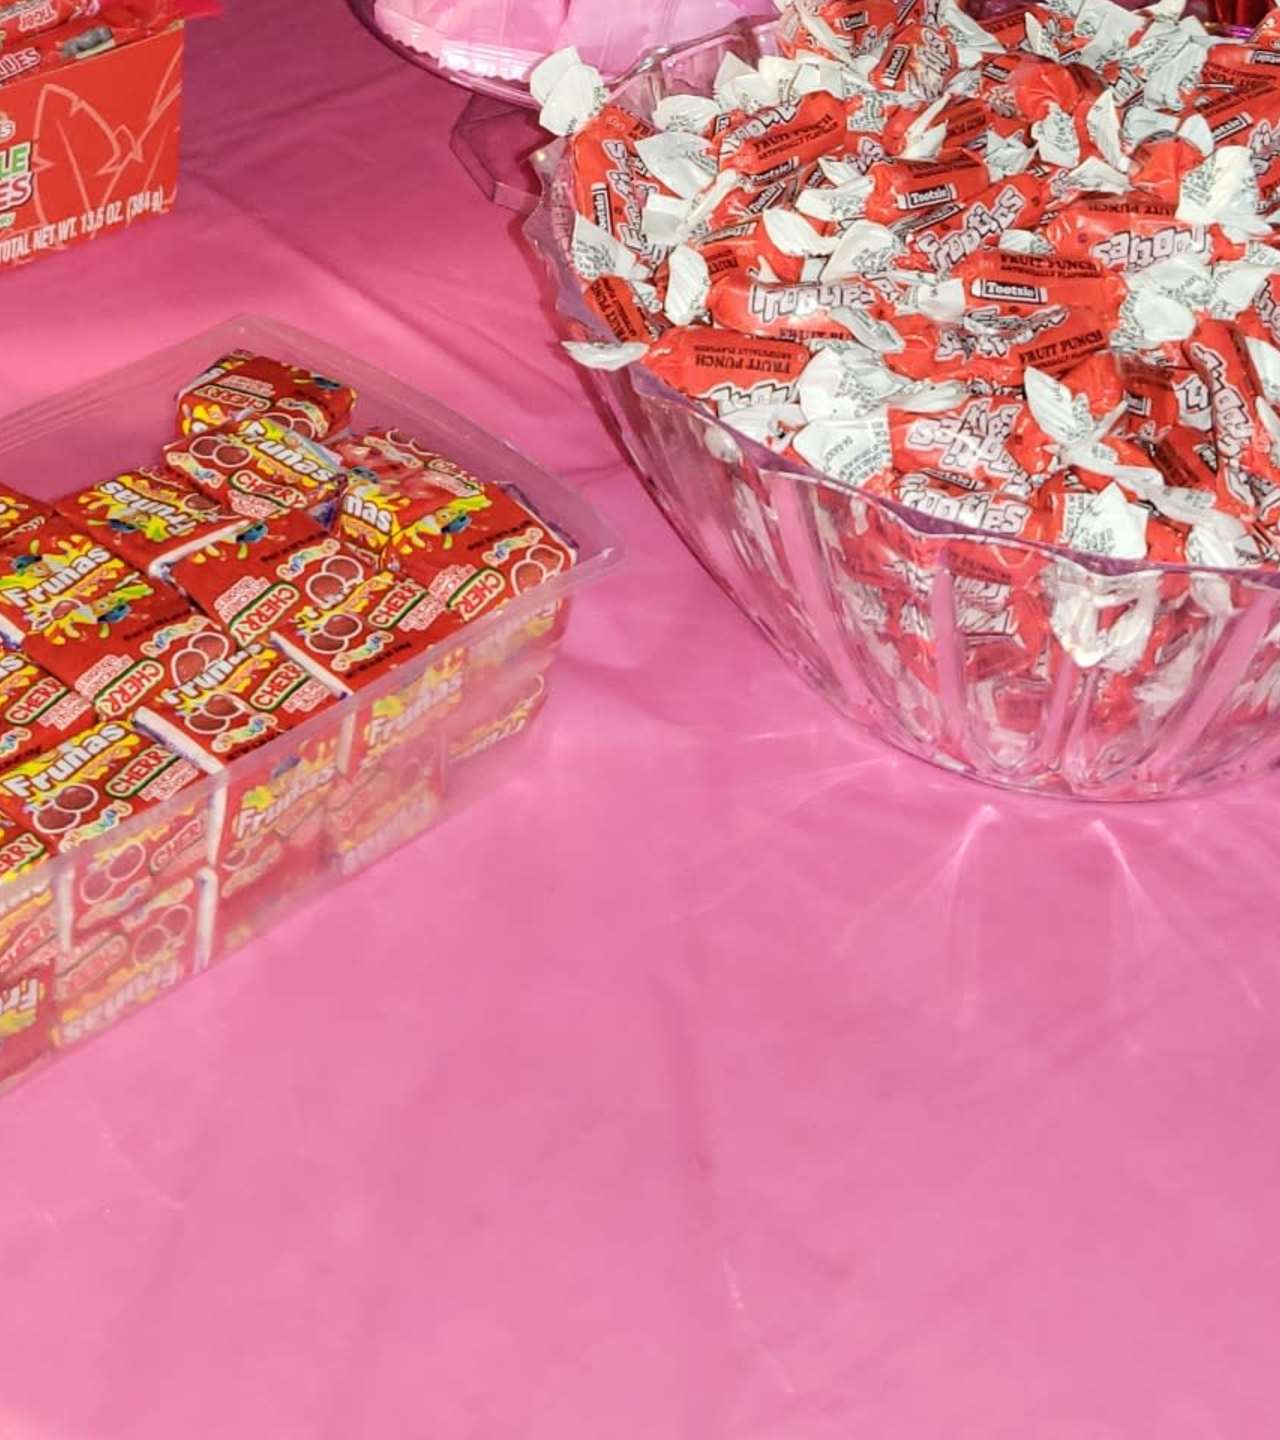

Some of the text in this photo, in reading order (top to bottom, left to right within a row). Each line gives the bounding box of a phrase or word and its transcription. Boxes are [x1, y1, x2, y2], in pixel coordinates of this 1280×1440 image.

[909, 186, 950, 206] Tootsie
[33, 224, 56, 250] NET
[919, 185, 1024, 274] Frooties
[1000, 253, 1045, 271] FRUIT
[587, 279, 614, 313] PUNC
[985, 280, 1037, 300] Tootsie
[694, 353, 791, 375] FRUIT PUNCH
[1020, 329, 1104, 365] FRUIT PUNCH
[231, 470, 308, 508] CHERRY
[343, 493, 393, 533] nas
[0, 544, 112, 608] Frunas
[447, 567, 505, 621] CHER
[230, 582, 300, 647] CHERRY
[368, 577, 427, 629] CHERR
[5, 676, 68, 724] CHERR
[93, 658, 164, 720] CHERR
[250, 662, 309, 712] CHERR
[3, 725, 126, 797] Frunas
[106, 747, 180, 797] CHERR
